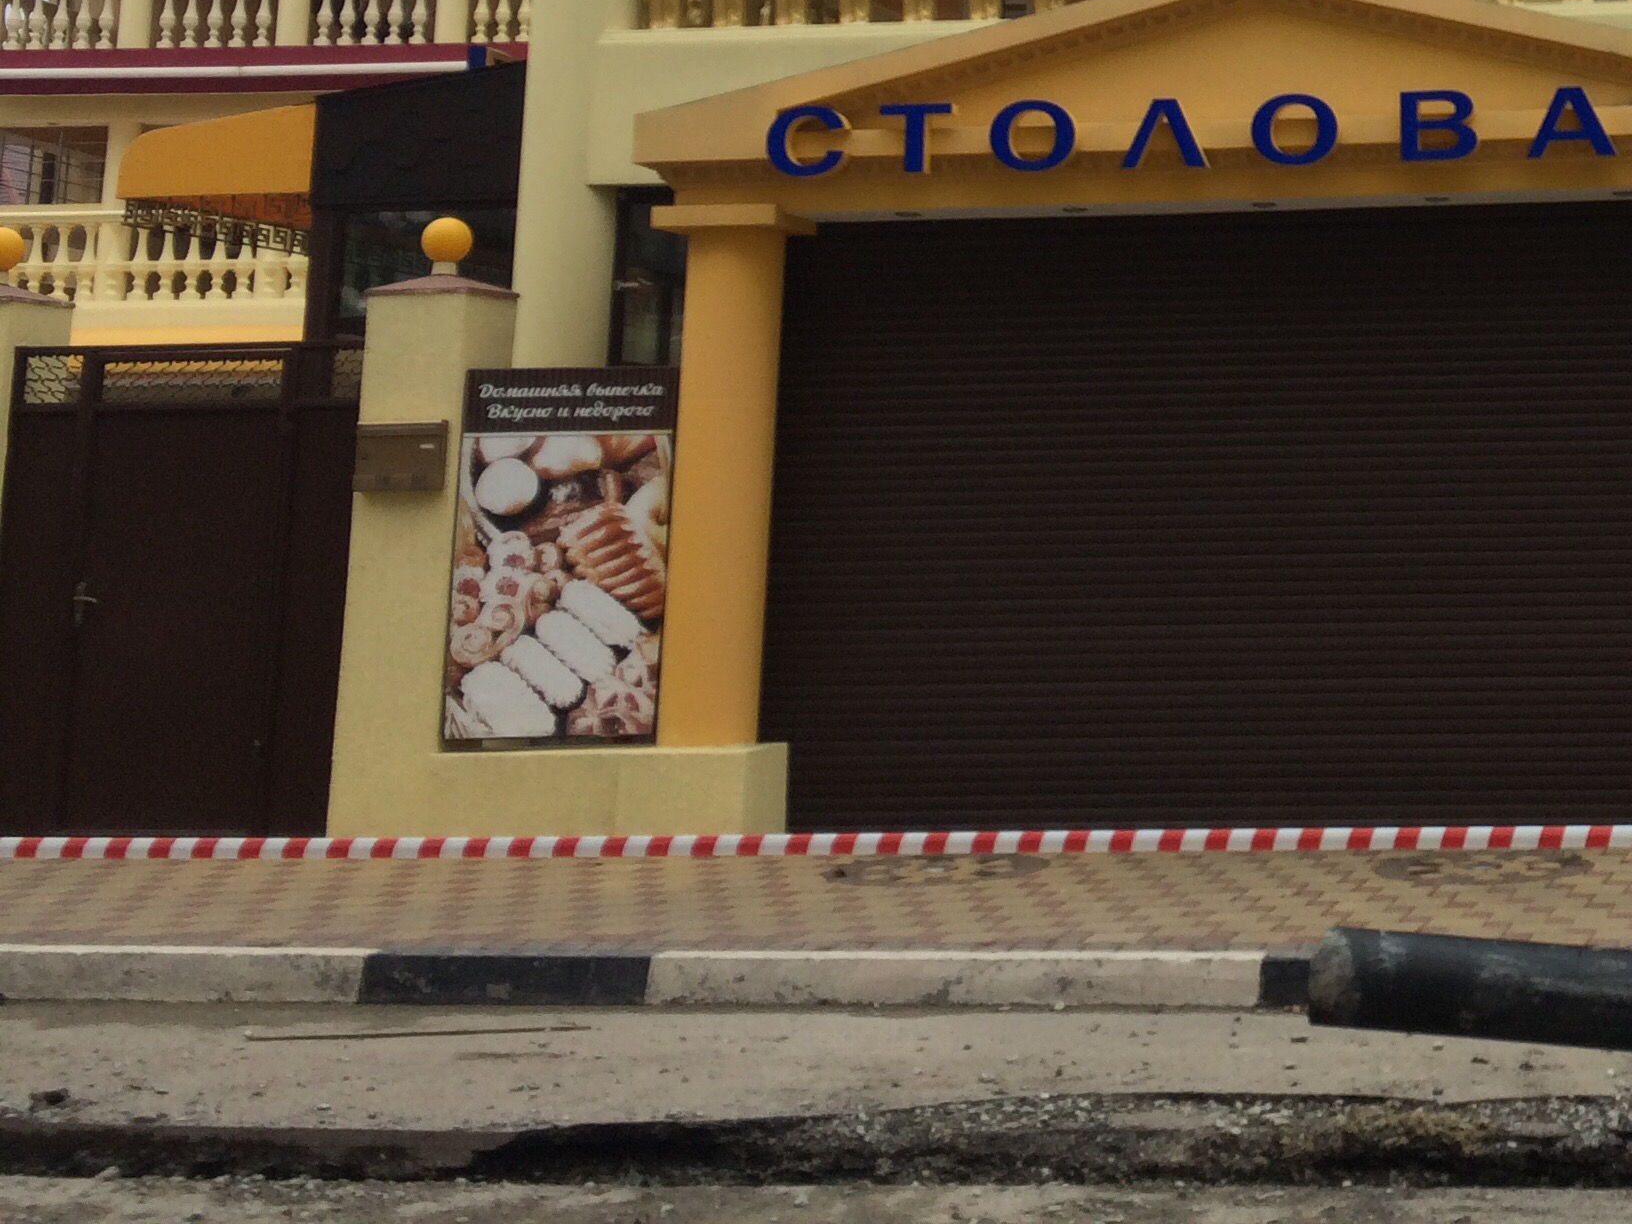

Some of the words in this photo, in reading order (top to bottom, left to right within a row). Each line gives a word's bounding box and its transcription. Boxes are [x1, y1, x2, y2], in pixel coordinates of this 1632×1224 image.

[478, 383, 583, 399] Домашняя
[586, 382, 665, 398] выпечка
[487, 403, 553, 422] Вкусно
[557, 407, 571, 418] и
[574, 400, 655, 422] недорого
